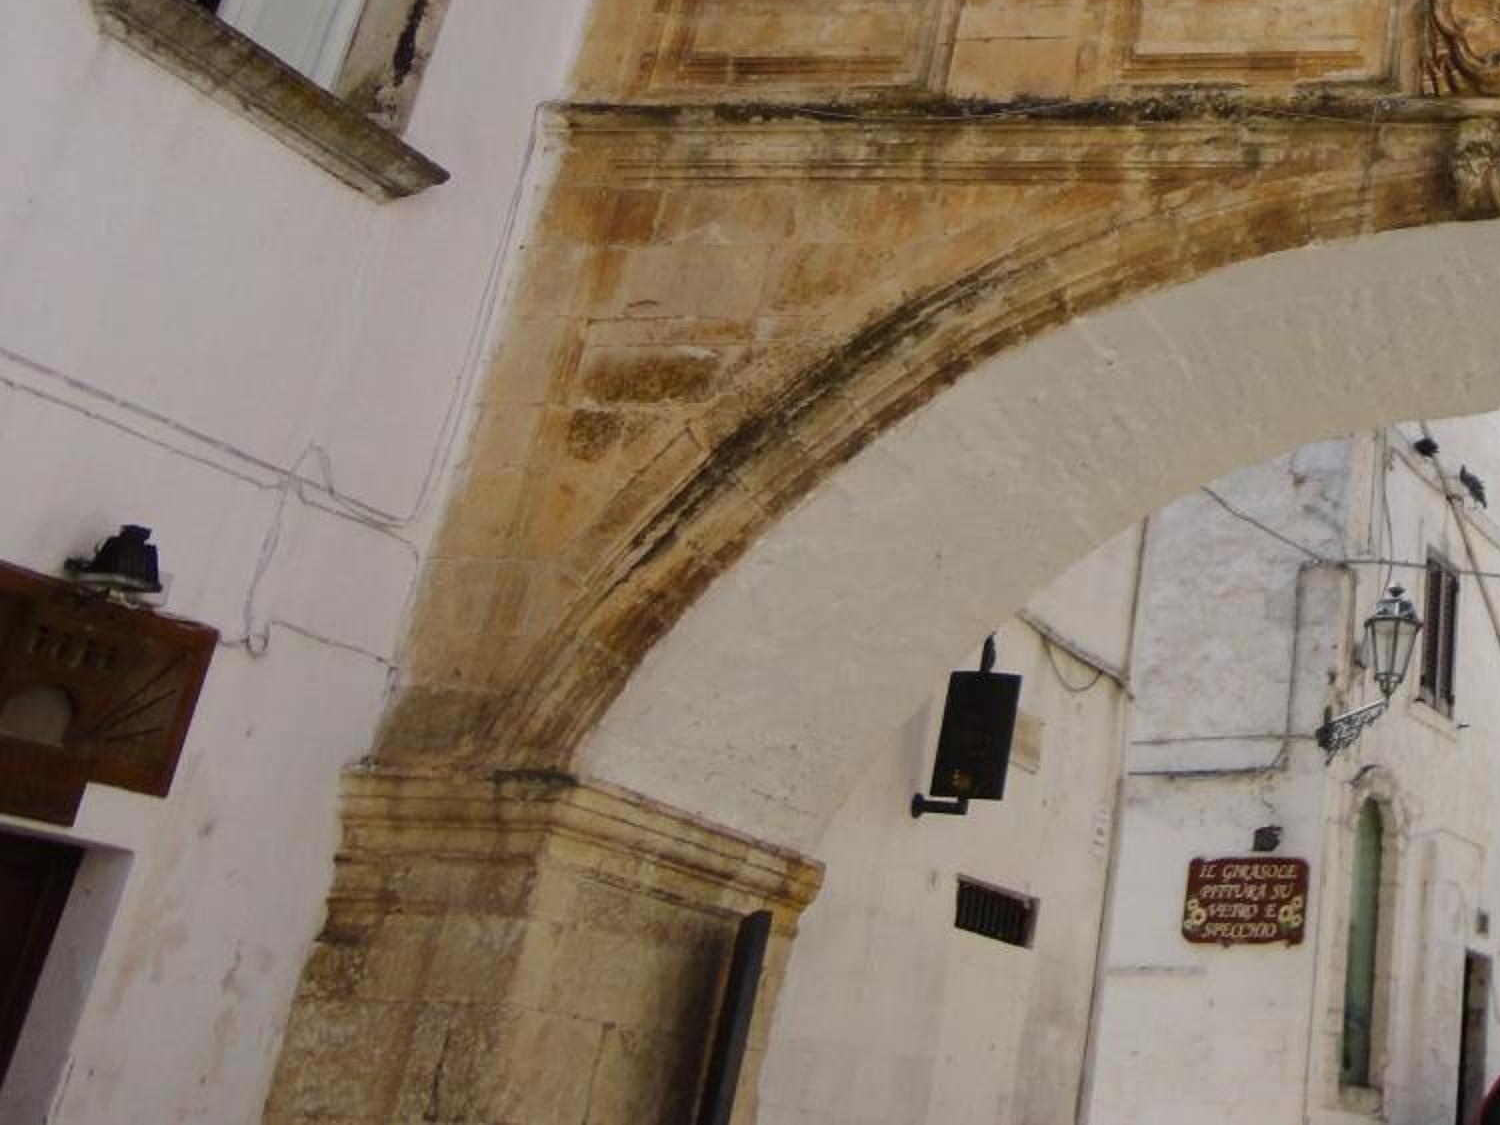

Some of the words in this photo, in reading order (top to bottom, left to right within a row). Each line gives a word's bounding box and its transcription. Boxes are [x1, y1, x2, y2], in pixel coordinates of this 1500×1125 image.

[1223, 863, 1298, 881] GIRASOLE
[1200, 883, 1268, 901] PITTURA
[1271, 882, 1293, 900] SU
[1201, 922, 1278, 938] SPECCHIO
